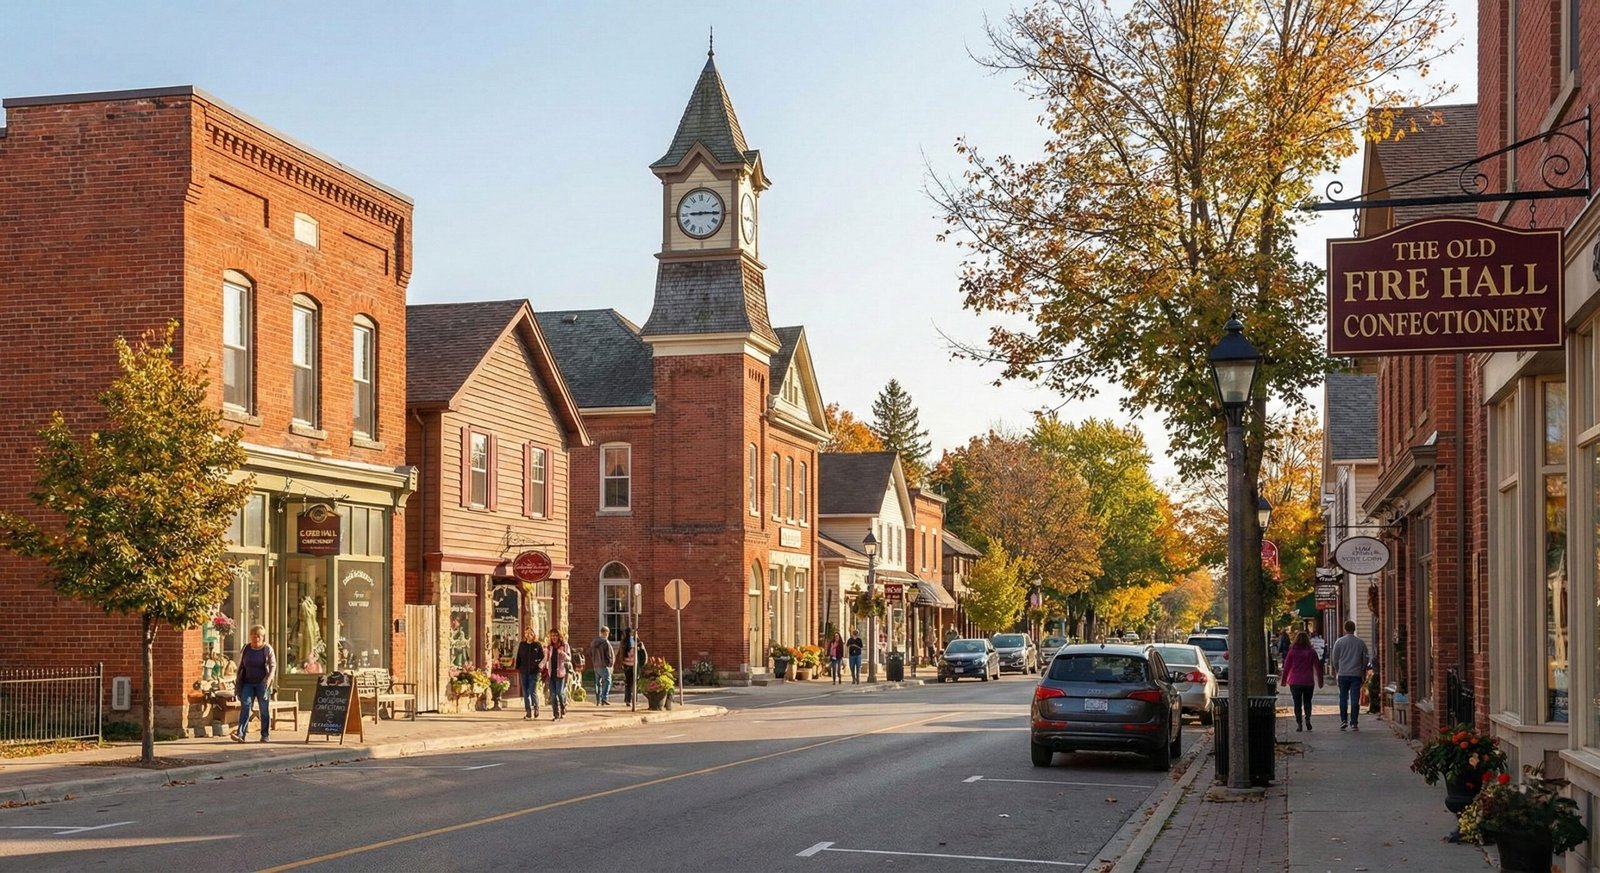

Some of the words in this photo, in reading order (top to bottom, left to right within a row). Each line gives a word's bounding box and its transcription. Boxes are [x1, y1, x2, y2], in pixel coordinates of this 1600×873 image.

[1392, 240, 1440, 261] THE
[1446, 238, 1496, 259] OLD
[1343, 267, 1430, 302] FIRE
[1441, 263, 1548, 297] HALL
[1343, 307, 1547, 338] CONFECTIONERY
